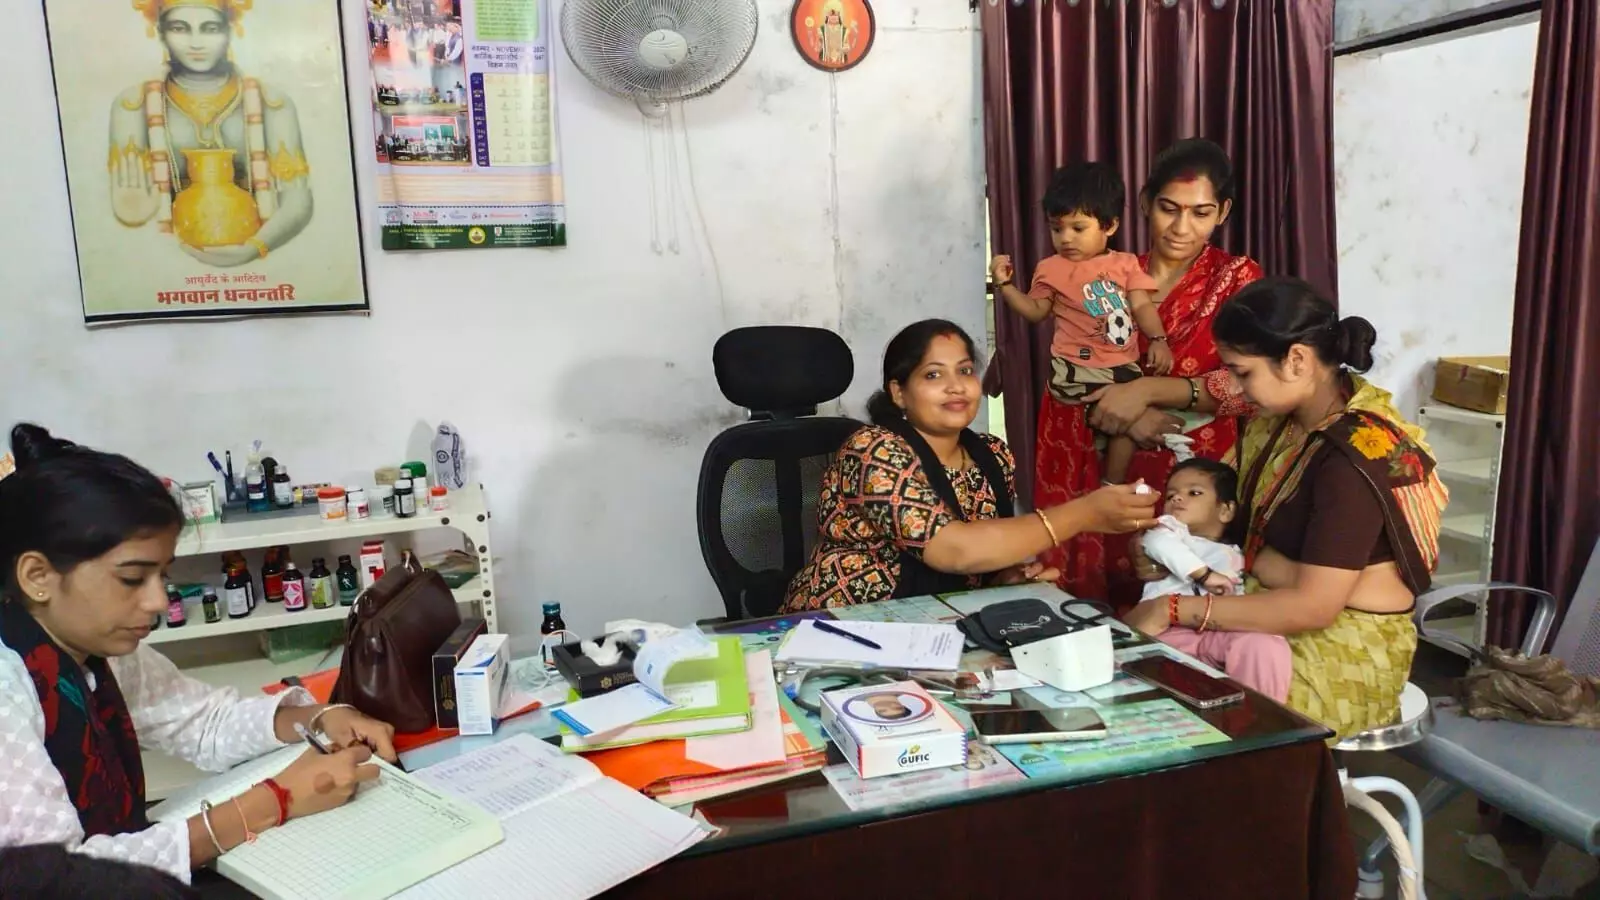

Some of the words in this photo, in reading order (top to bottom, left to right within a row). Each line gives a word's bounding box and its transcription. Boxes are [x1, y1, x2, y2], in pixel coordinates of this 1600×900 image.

[185, 274, 218, 287] आयुर्वेद
[220, 273, 229, 284] के
[157, 289, 220, 304] भगवान
[900, 753, 930, 765] GUFIC
